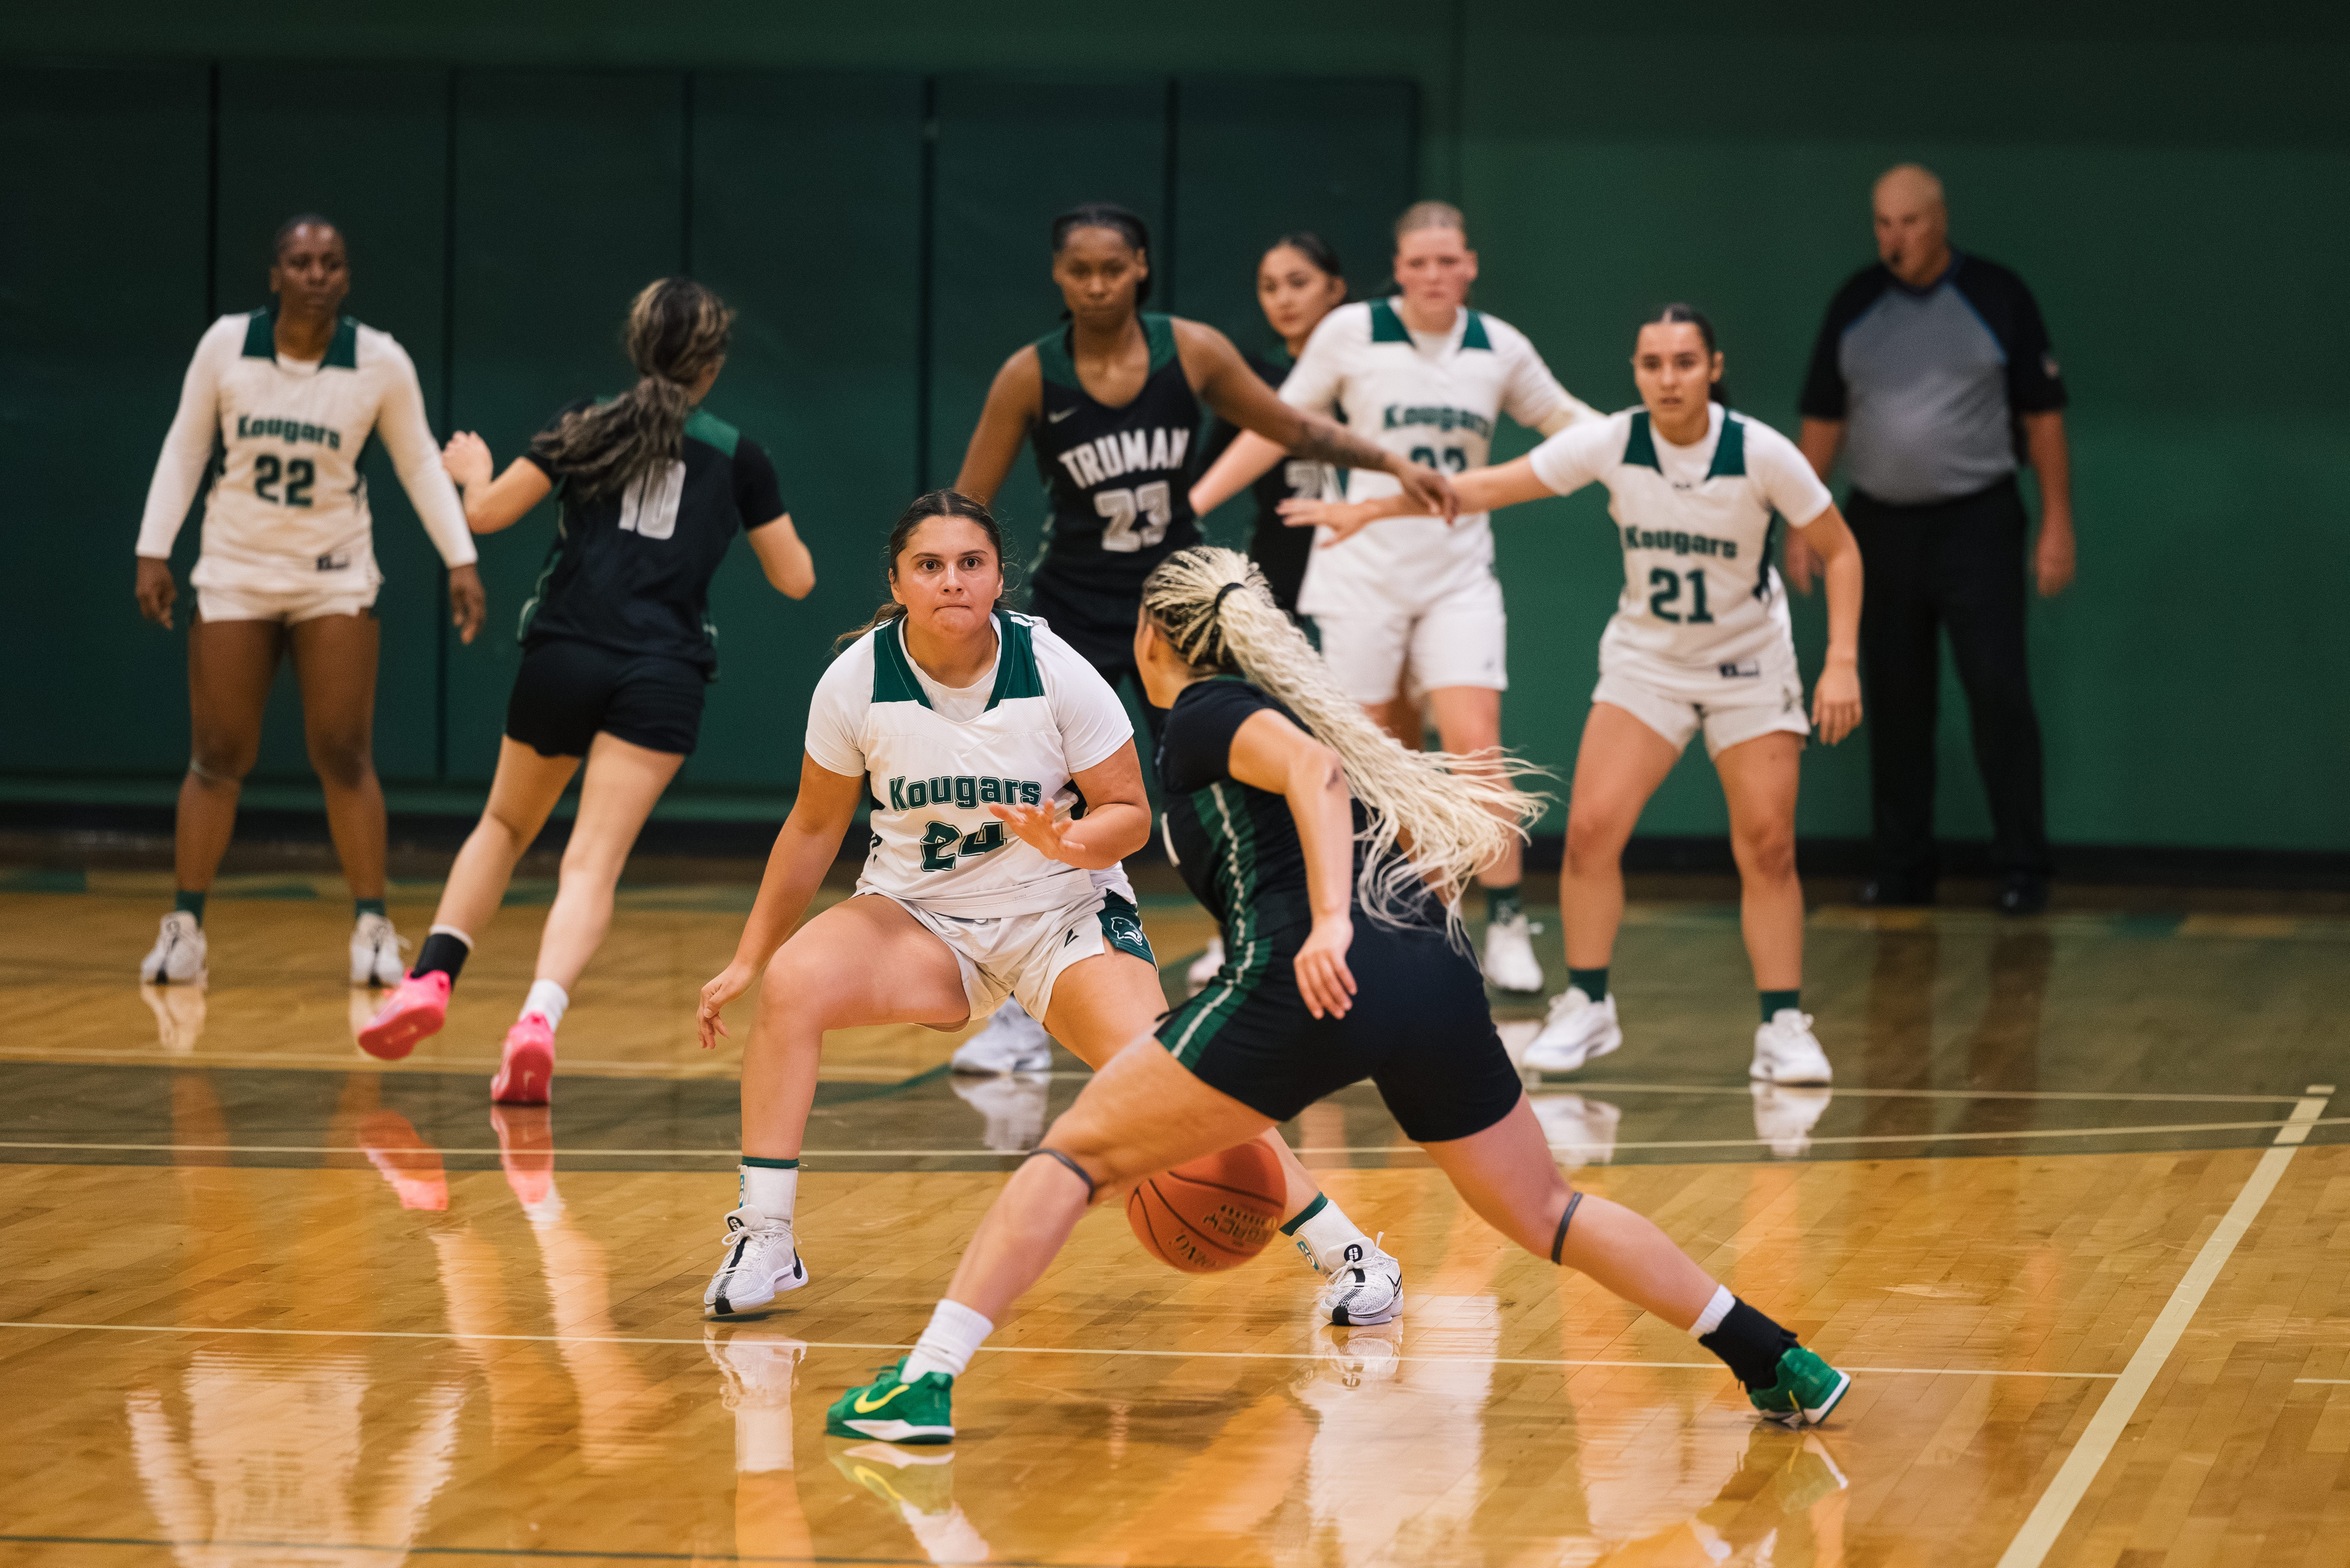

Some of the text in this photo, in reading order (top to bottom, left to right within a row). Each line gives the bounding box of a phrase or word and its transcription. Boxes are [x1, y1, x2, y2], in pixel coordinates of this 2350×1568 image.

[236, 415, 341, 450] Kougars
[1057, 427, 1190, 490] TRUMAN
[255, 454, 314, 507] 22
[618, 459, 687, 540] 10
[1093, 480, 1172, 552] 23
[1625, 525, 1737, 559] Kougars
[1649, 567, 1714, 623] 21
[889, 775, 1042, 811] Kougars
[920, 820, 1008, 872] 24
